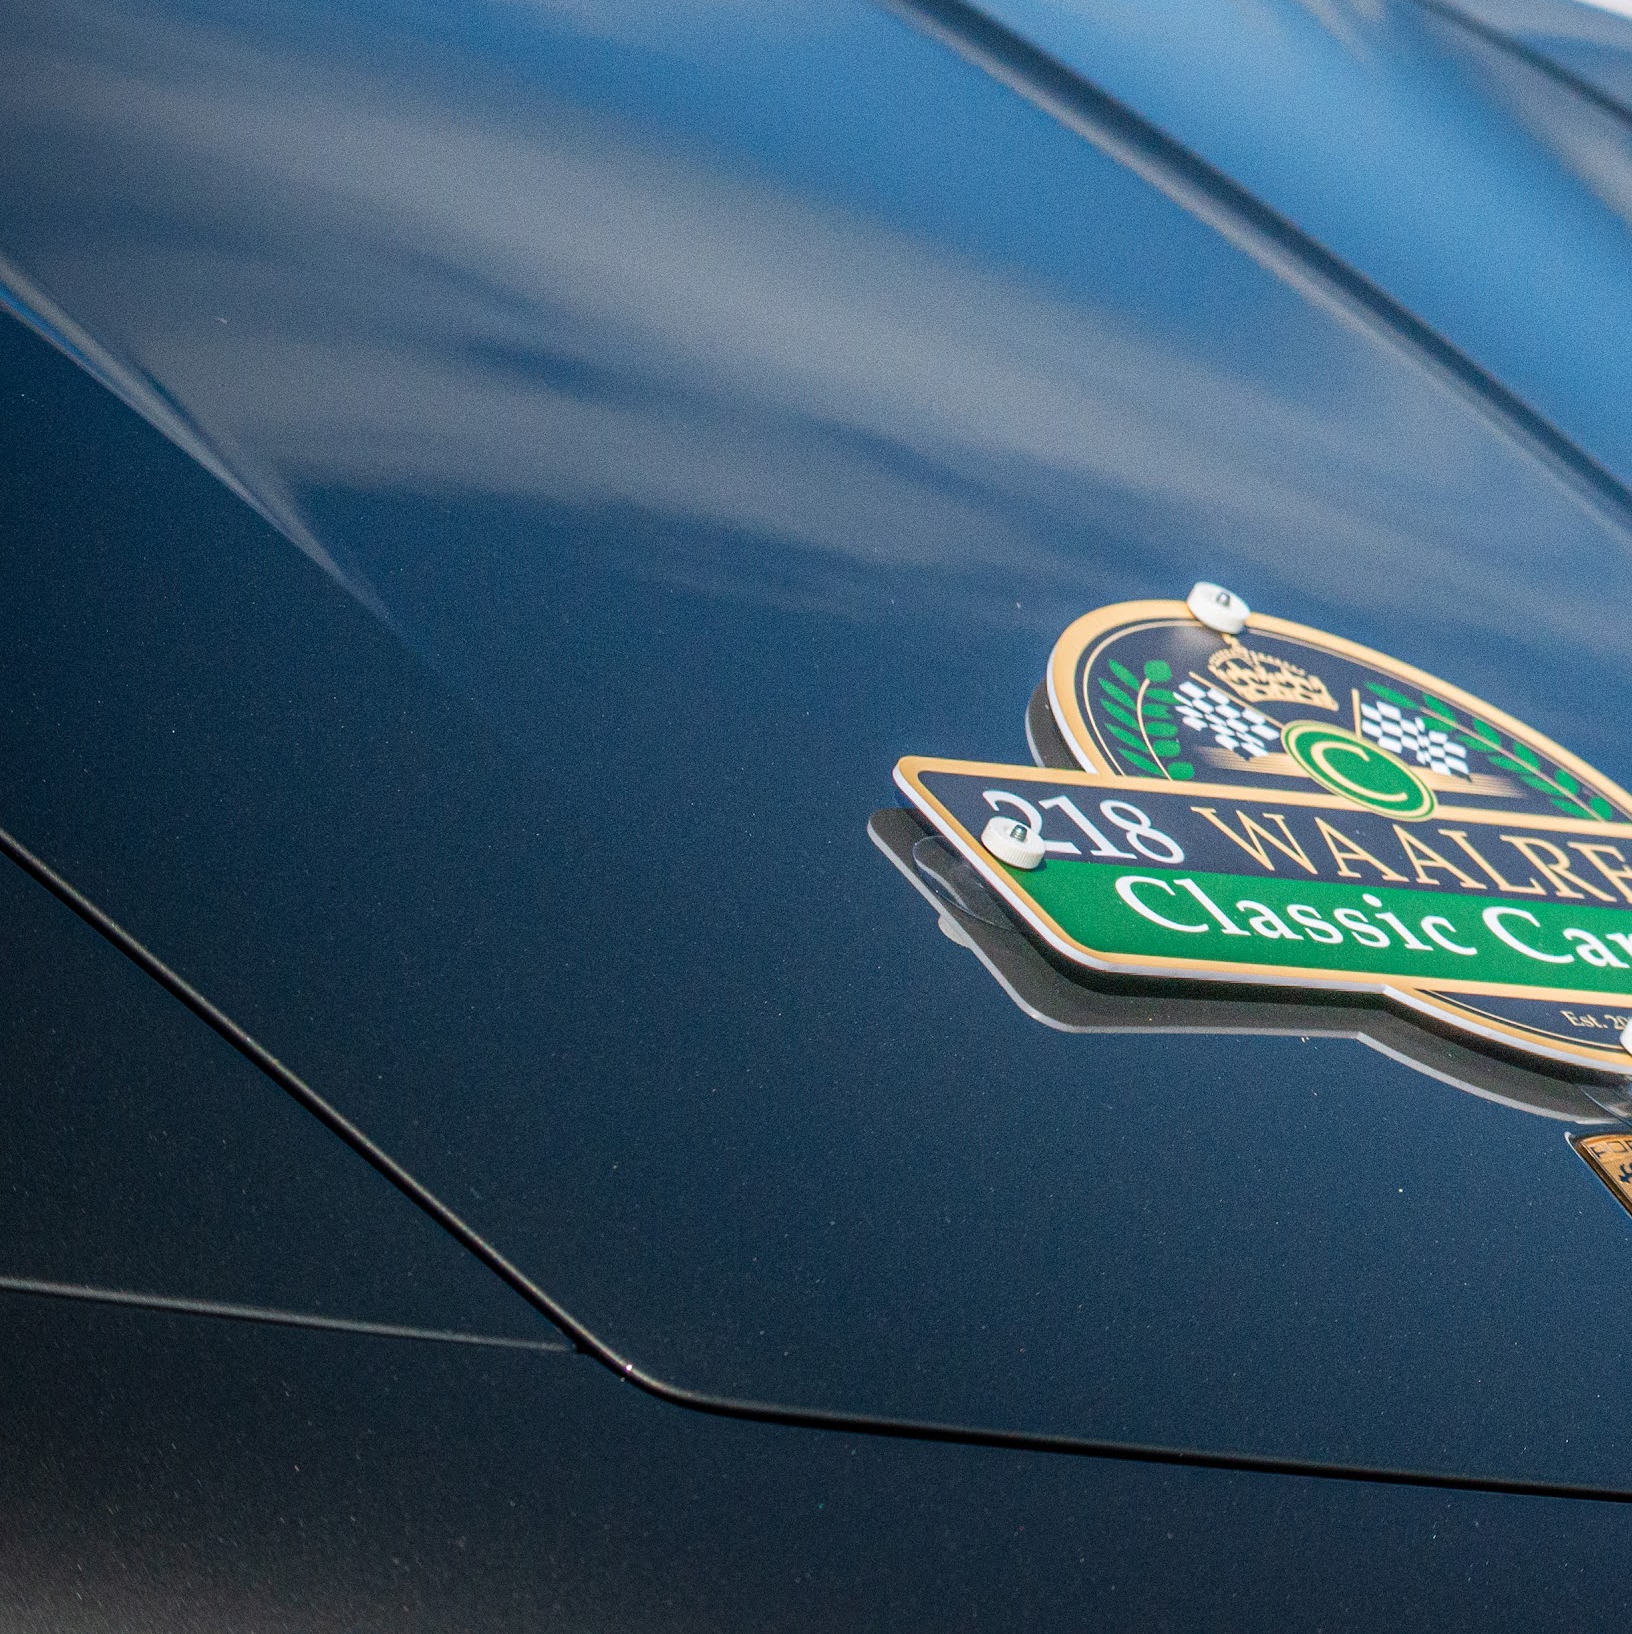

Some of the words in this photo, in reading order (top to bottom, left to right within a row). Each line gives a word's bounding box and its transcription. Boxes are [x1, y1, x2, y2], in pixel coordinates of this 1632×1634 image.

[982, 790, 1185, 864] 218
[1115, 875, 1478, 956] Classic
[1559, 1010, 1608, 1029] Est.
